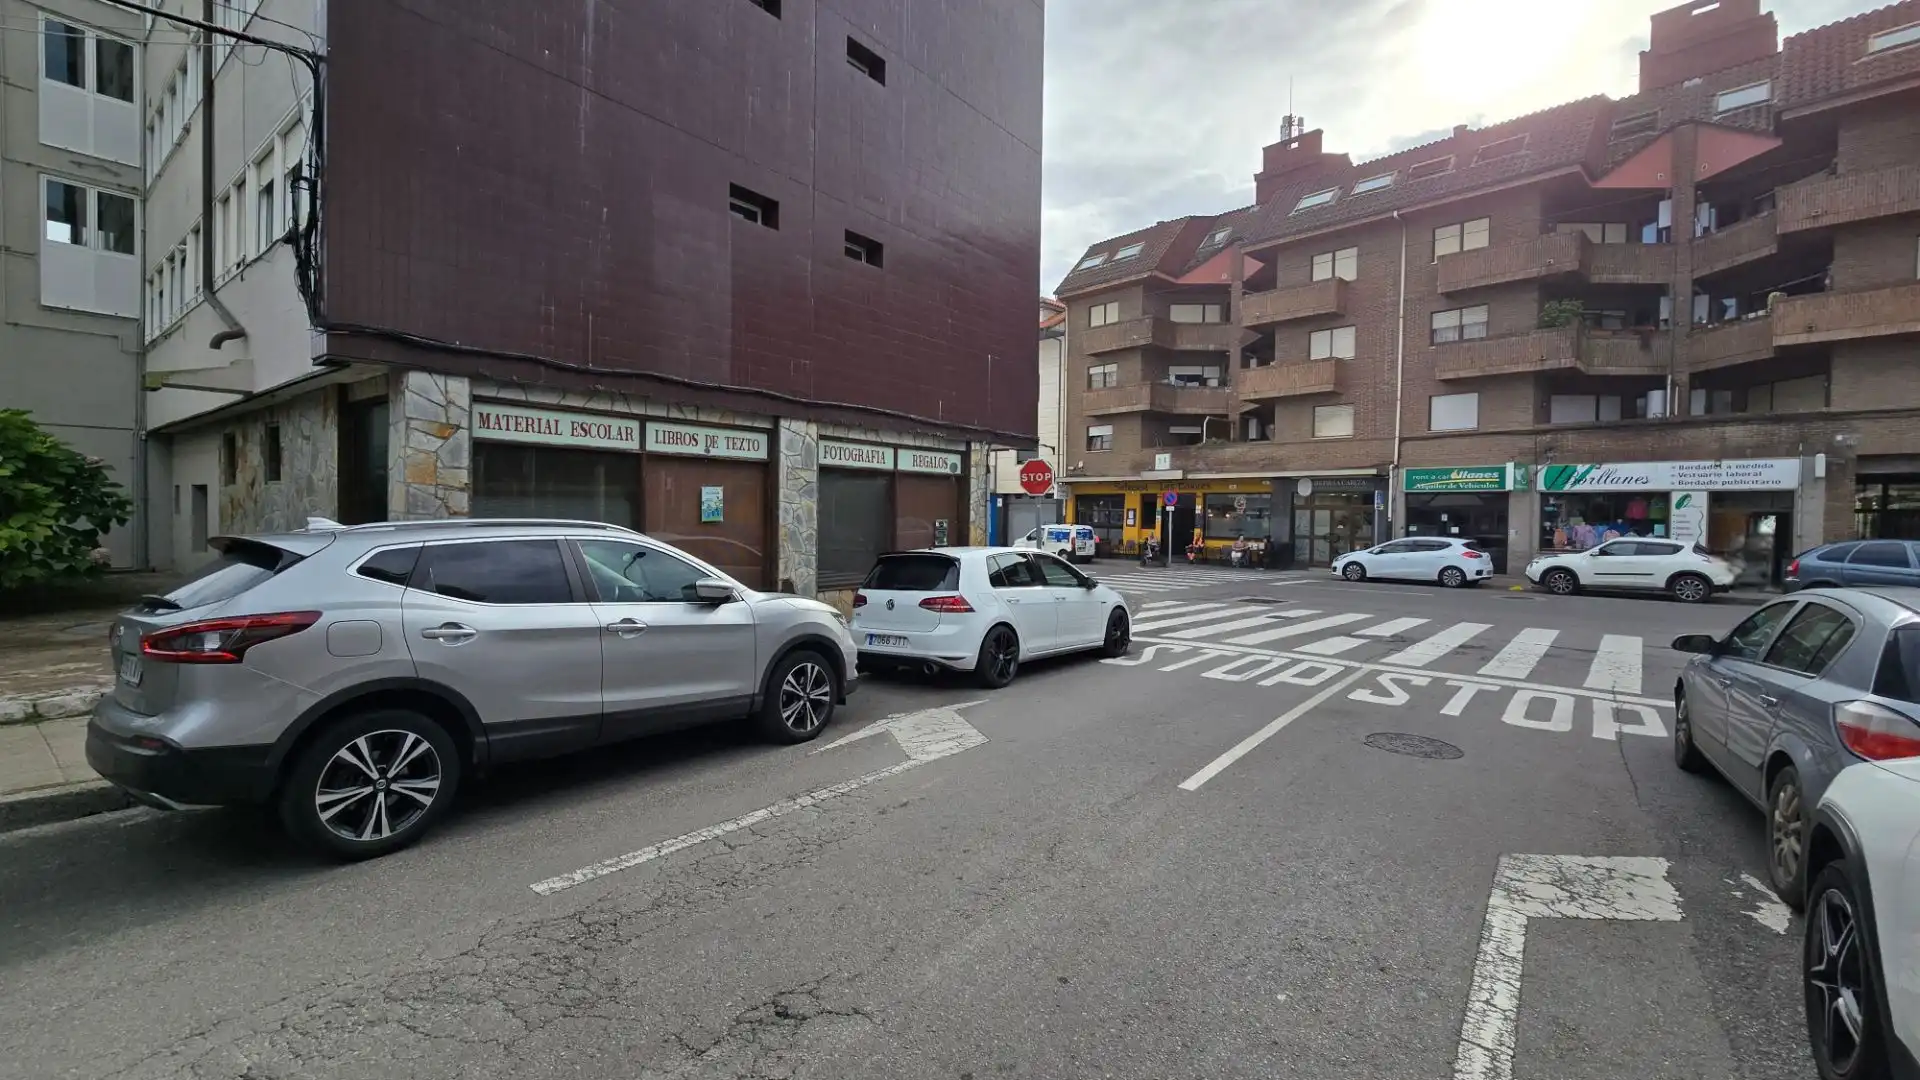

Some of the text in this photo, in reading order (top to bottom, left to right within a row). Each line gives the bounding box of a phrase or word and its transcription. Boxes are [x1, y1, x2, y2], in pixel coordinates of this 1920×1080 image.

[478, 411, 635, 442] MATERIAL ESCOLAR
[654, 429, 760, 452] LIBROS DE TEXTO
[823, 445, 949, 470] FOTOGRAFIA REGALOS
[1021, 473, 1051, 482] STOP
[1098, 643, 1346, 687] STOP
[1346, 672, 1669, 740] STOP
